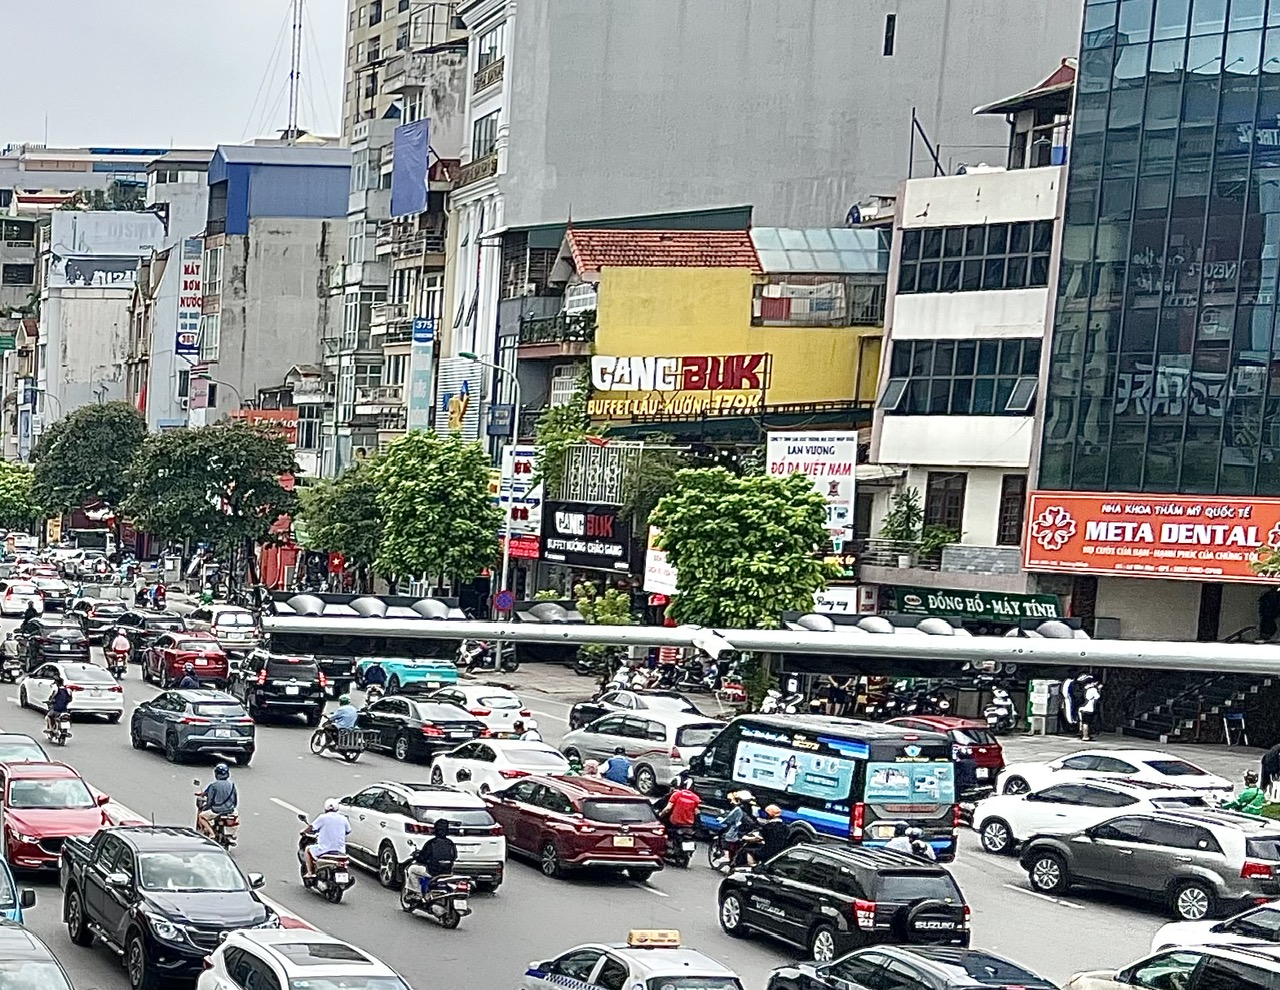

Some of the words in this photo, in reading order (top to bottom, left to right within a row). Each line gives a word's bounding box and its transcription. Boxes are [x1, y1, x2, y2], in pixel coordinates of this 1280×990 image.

[416, 320, 433, 329] 375
[682, 354, 764, 390] BUK
[587, 399, 631, 415] BUFFET
[827, 463, 852, 476] NAM
[1125, 505, 1151, 515] KHOA
[1084, 521, 1154, 543] META
[1160, 523, 1262, 547] DENTAL
[927, 591, 963, 611] ĐỒNG
[992, 597, 1020, 615] MÁY
[1022, 599, 1057, 618] TÍNH
[914, 921, 955, 930] SUZUKI
